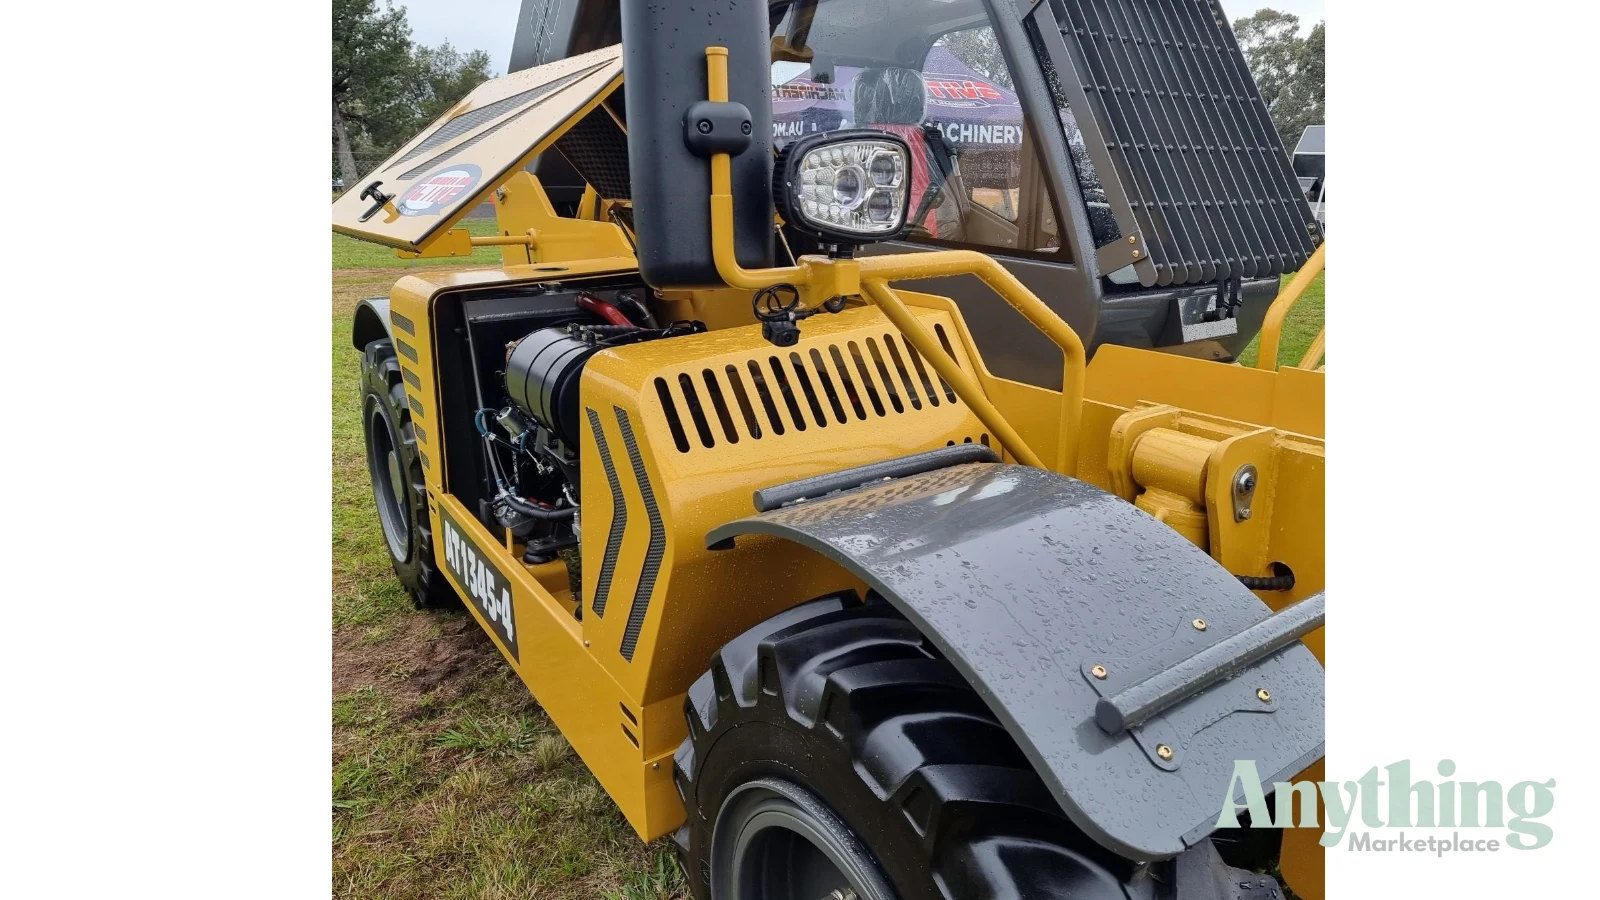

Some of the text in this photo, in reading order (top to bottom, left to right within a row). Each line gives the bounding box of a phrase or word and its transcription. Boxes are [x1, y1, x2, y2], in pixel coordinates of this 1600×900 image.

[926, 80, 1004, 100] TIVE
[927, 122, 1023, 144] ACHINERY
[444, 519, 514, 643] AT1345-4
